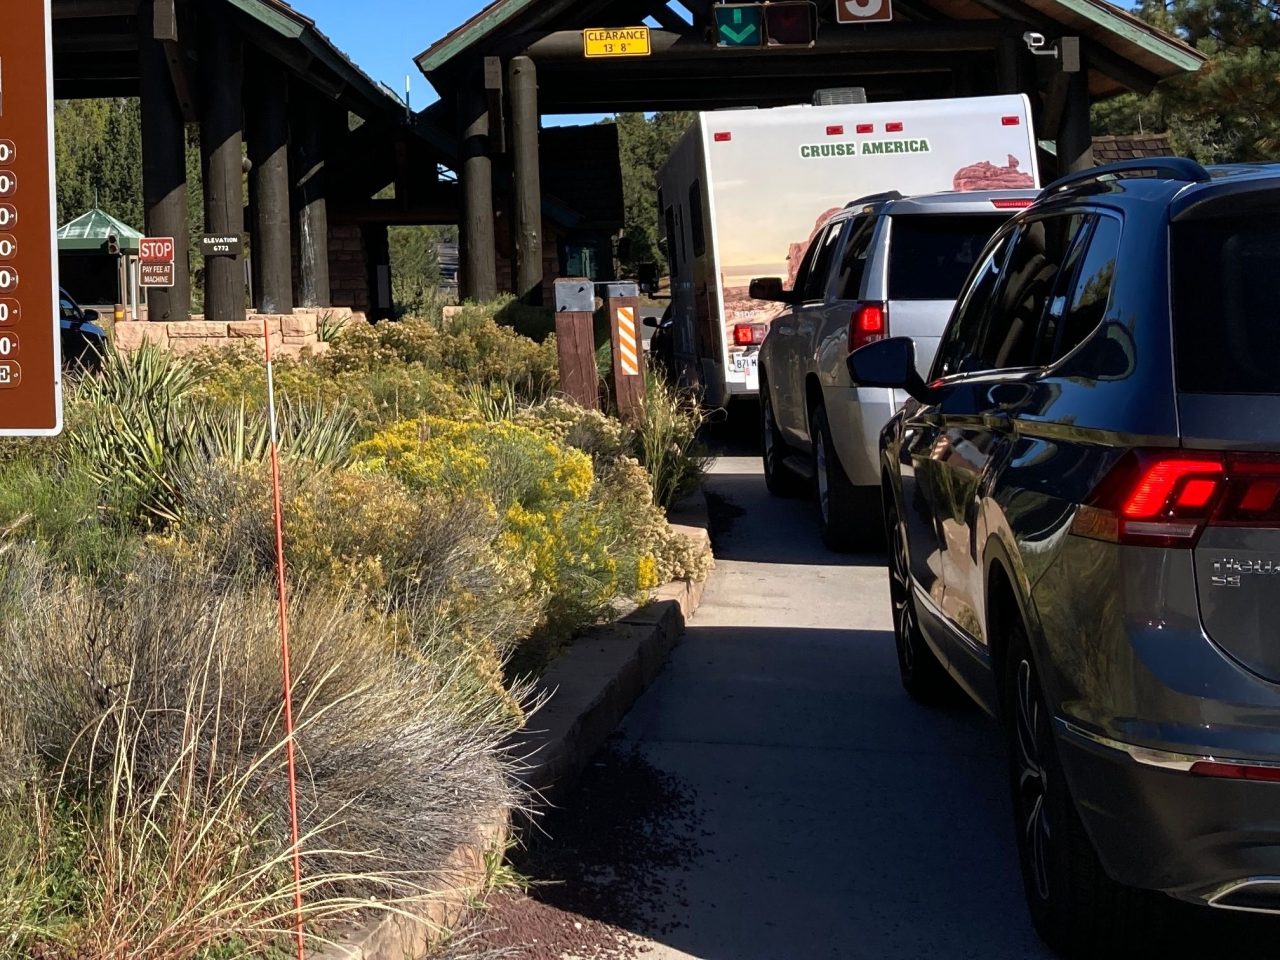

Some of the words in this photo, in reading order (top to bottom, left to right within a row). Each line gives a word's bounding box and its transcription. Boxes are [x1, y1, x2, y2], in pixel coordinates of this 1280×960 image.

[588, 30, 646, 41] CLEARANCE
[800, 143, 856, 158] CRUISE
[862, 139, 930, 155] AMERICA
[142, 242, 171, 257] STOP
[142, 265, 152, 273] PAY
[153, 265, 163, 273] FEE
[144, 275, 168, 283] MACHINE
